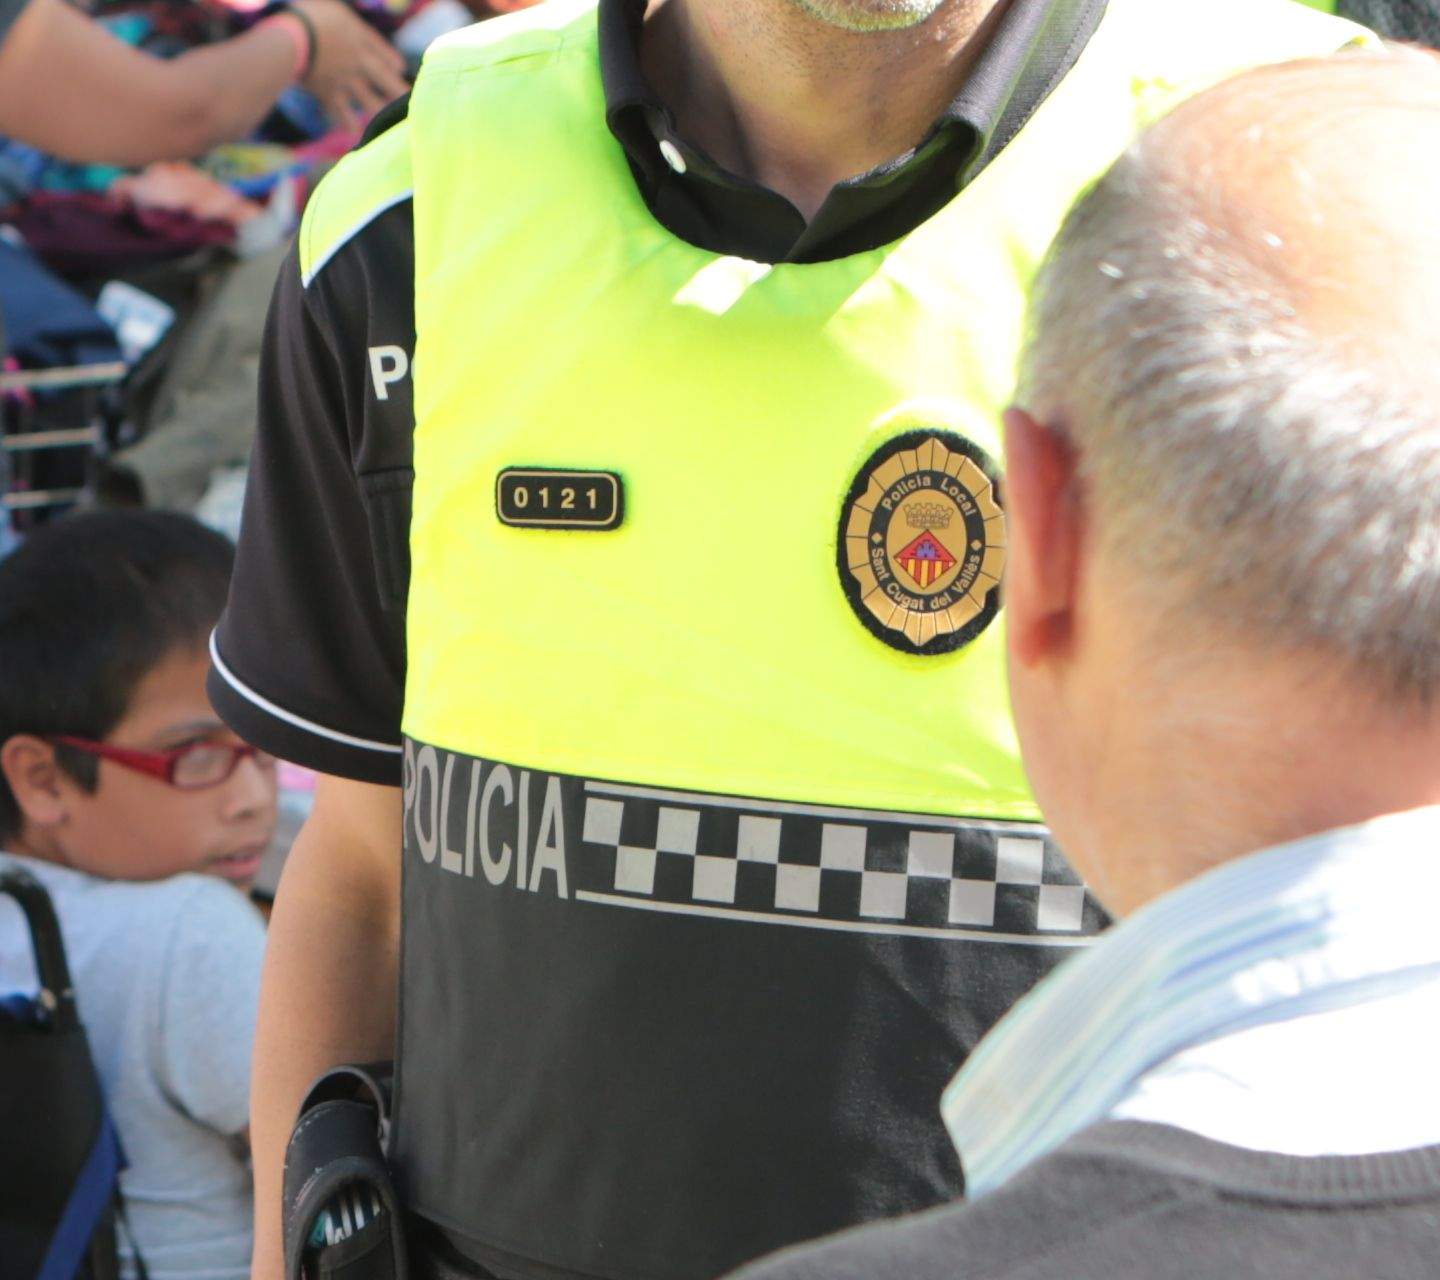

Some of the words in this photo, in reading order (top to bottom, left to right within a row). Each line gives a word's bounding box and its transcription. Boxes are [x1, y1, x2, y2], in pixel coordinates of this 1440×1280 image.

[367, 344, 414, 401] P
[512, 486, 599, 510] 0121
[881, 474, 932, 511] Policia
[940, 476, 977, 517] Local
[871, 546, 890, 580] Sant
[886, 582, 925, 611] Cugat
[930, 592, 953, 611] del
[403, 736, 569, 901] POLICIA
